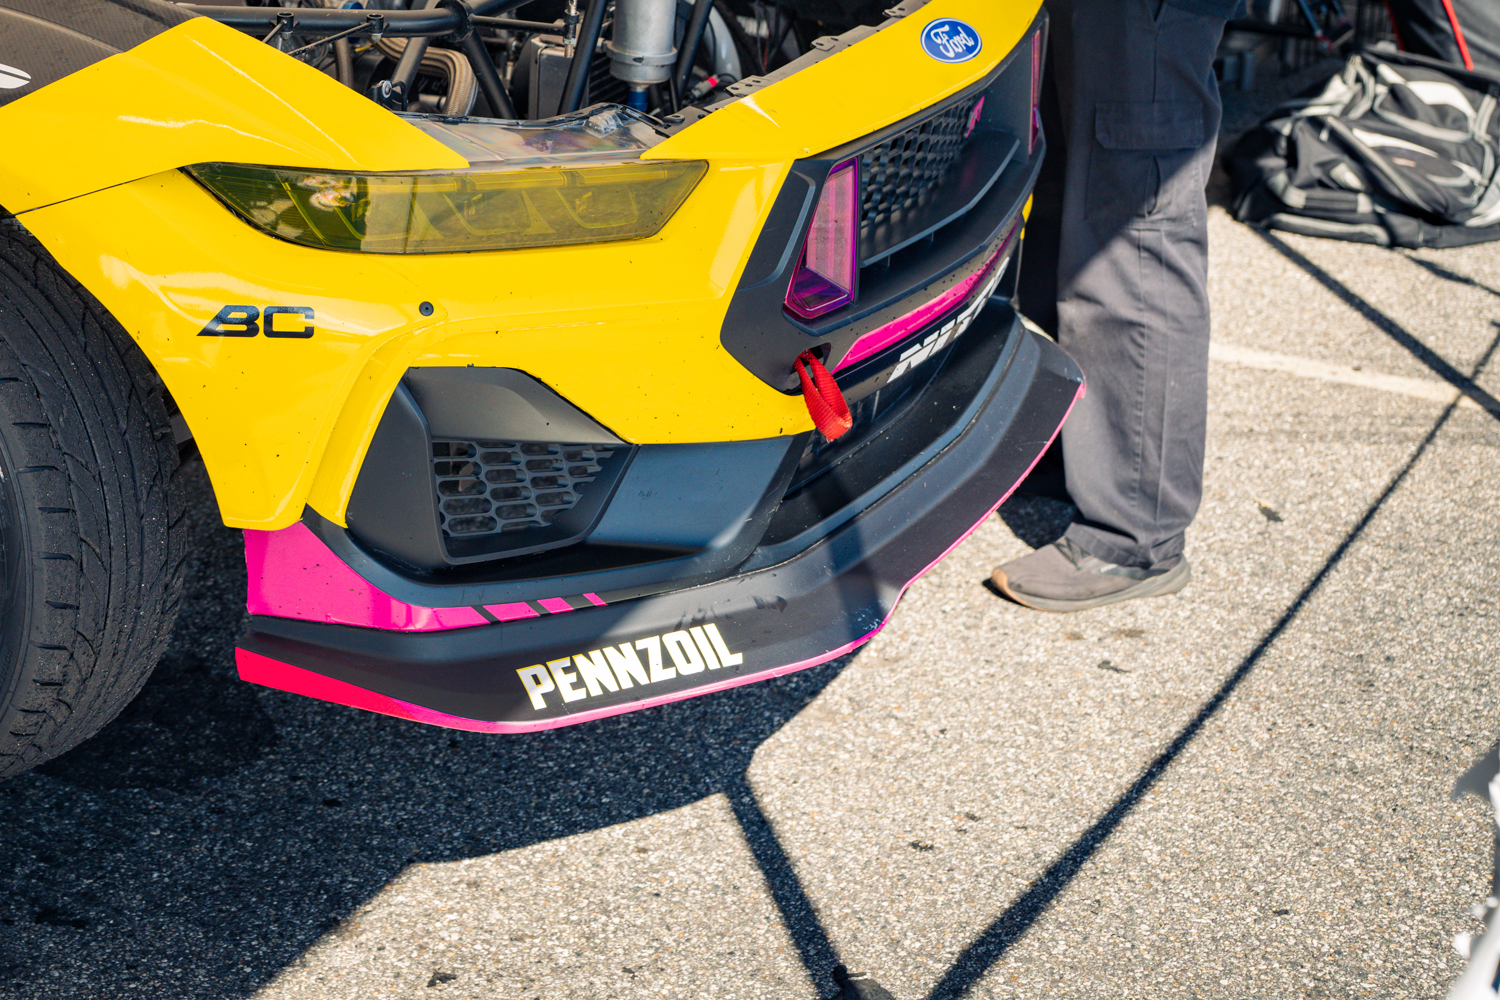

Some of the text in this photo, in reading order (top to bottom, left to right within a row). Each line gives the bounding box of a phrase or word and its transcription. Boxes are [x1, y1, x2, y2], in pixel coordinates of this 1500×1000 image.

[929, 23, 976, 59] Ford
[195, 304, 316, 340] BC
[515, 622, 744, 711] PENNZOIL
